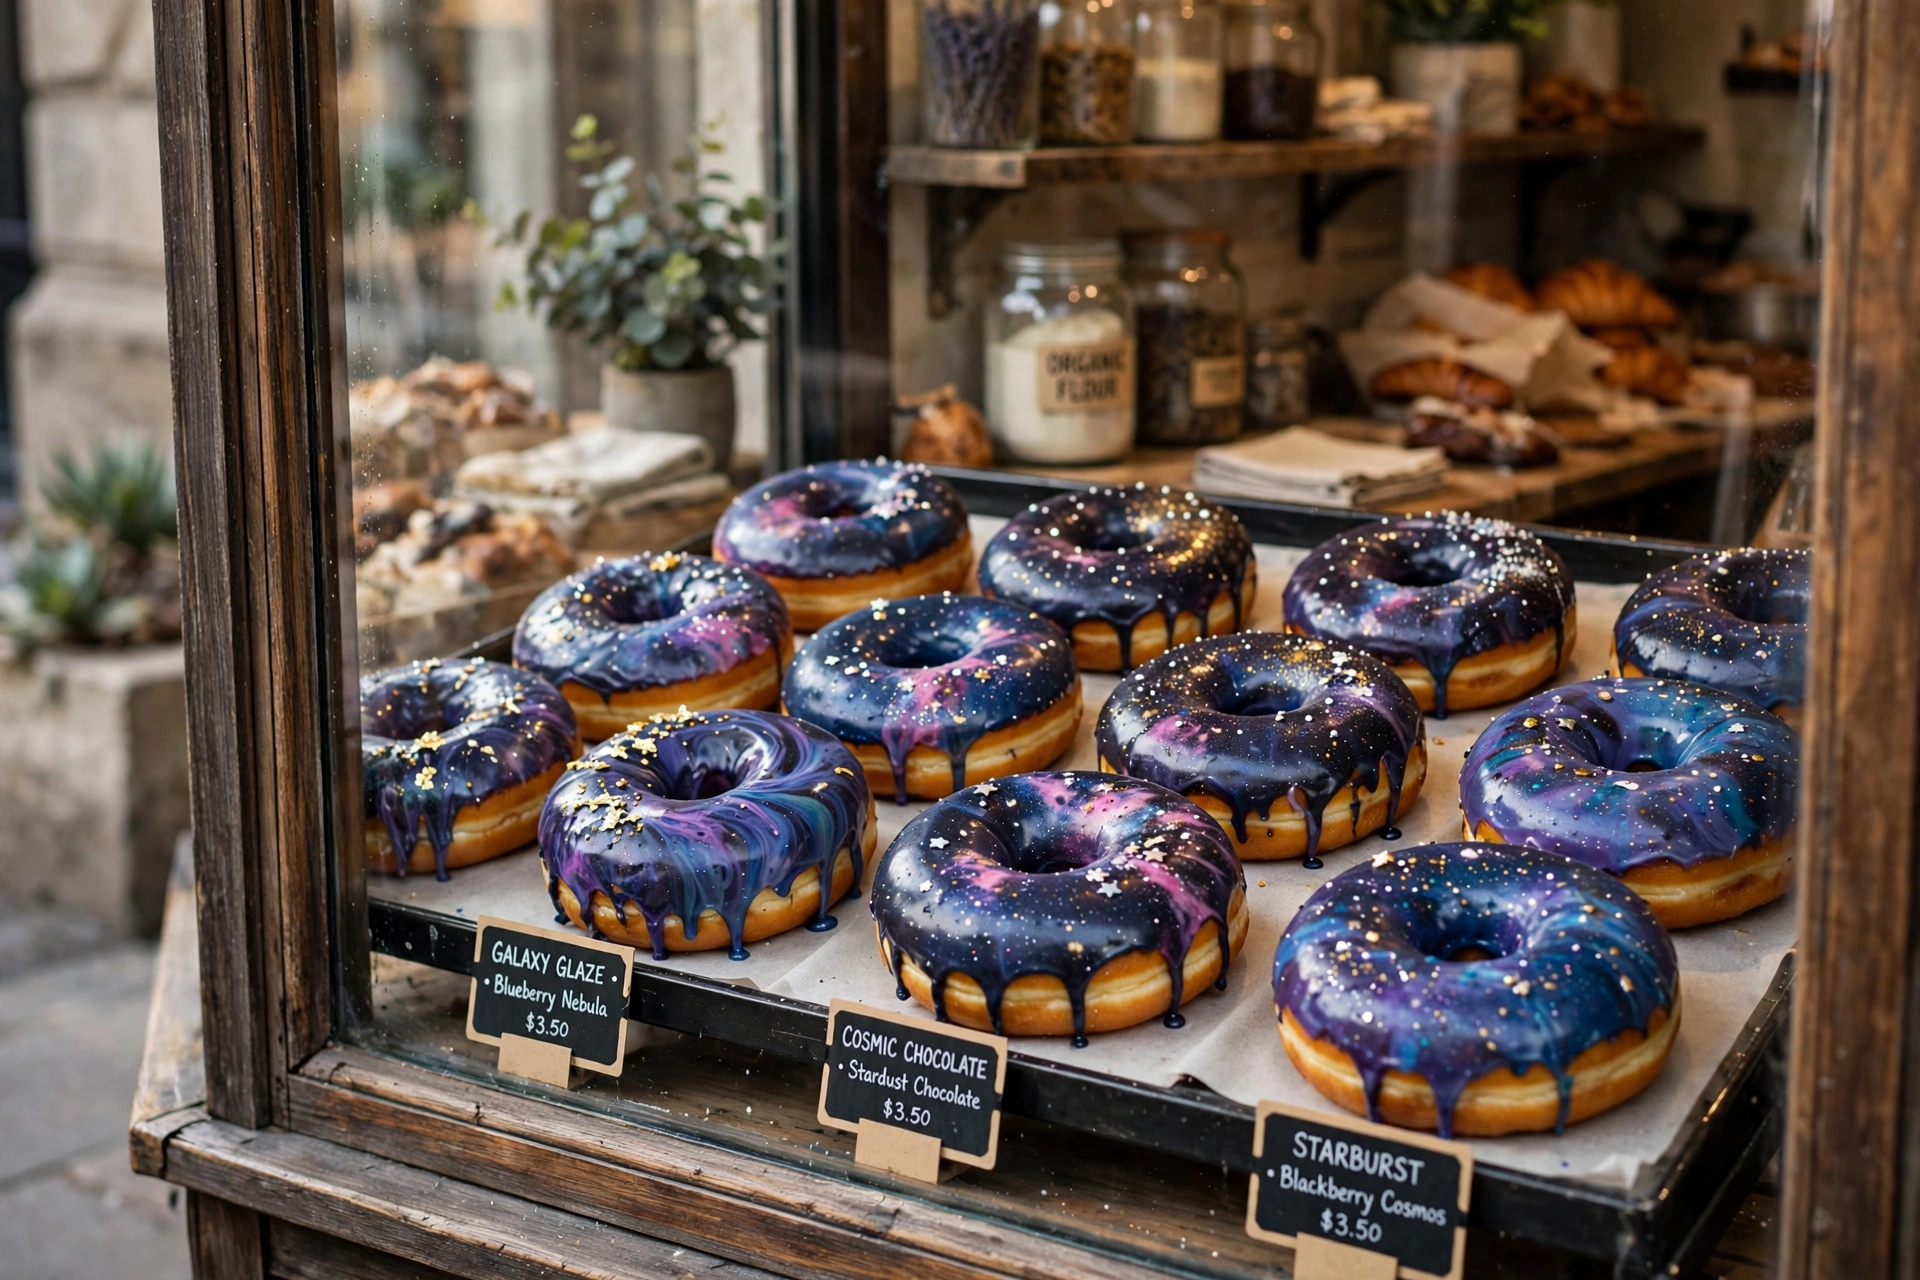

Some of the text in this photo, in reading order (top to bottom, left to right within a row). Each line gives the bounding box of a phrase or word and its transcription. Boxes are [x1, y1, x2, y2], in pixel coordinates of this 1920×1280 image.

[492, 941, 606, 985] GALAXY GLAZE
[494, 973, 608, 1018] Blueberry Nebula
[525, 1011, 569, 1038] $3.50
[842, 1025, 988, 1080] COSMIC CHOCOLATE
[848, 1059, 981, 1110] Stardust Chocolate
[883, 1098, 931, 1126] $3.50
[1292, 1131, 1425, 1186] STARBURST
[1279, 1164, 1447, 1226] Blackberry Cosmos
[1320, 1208, 1383, 1242] $3.50
